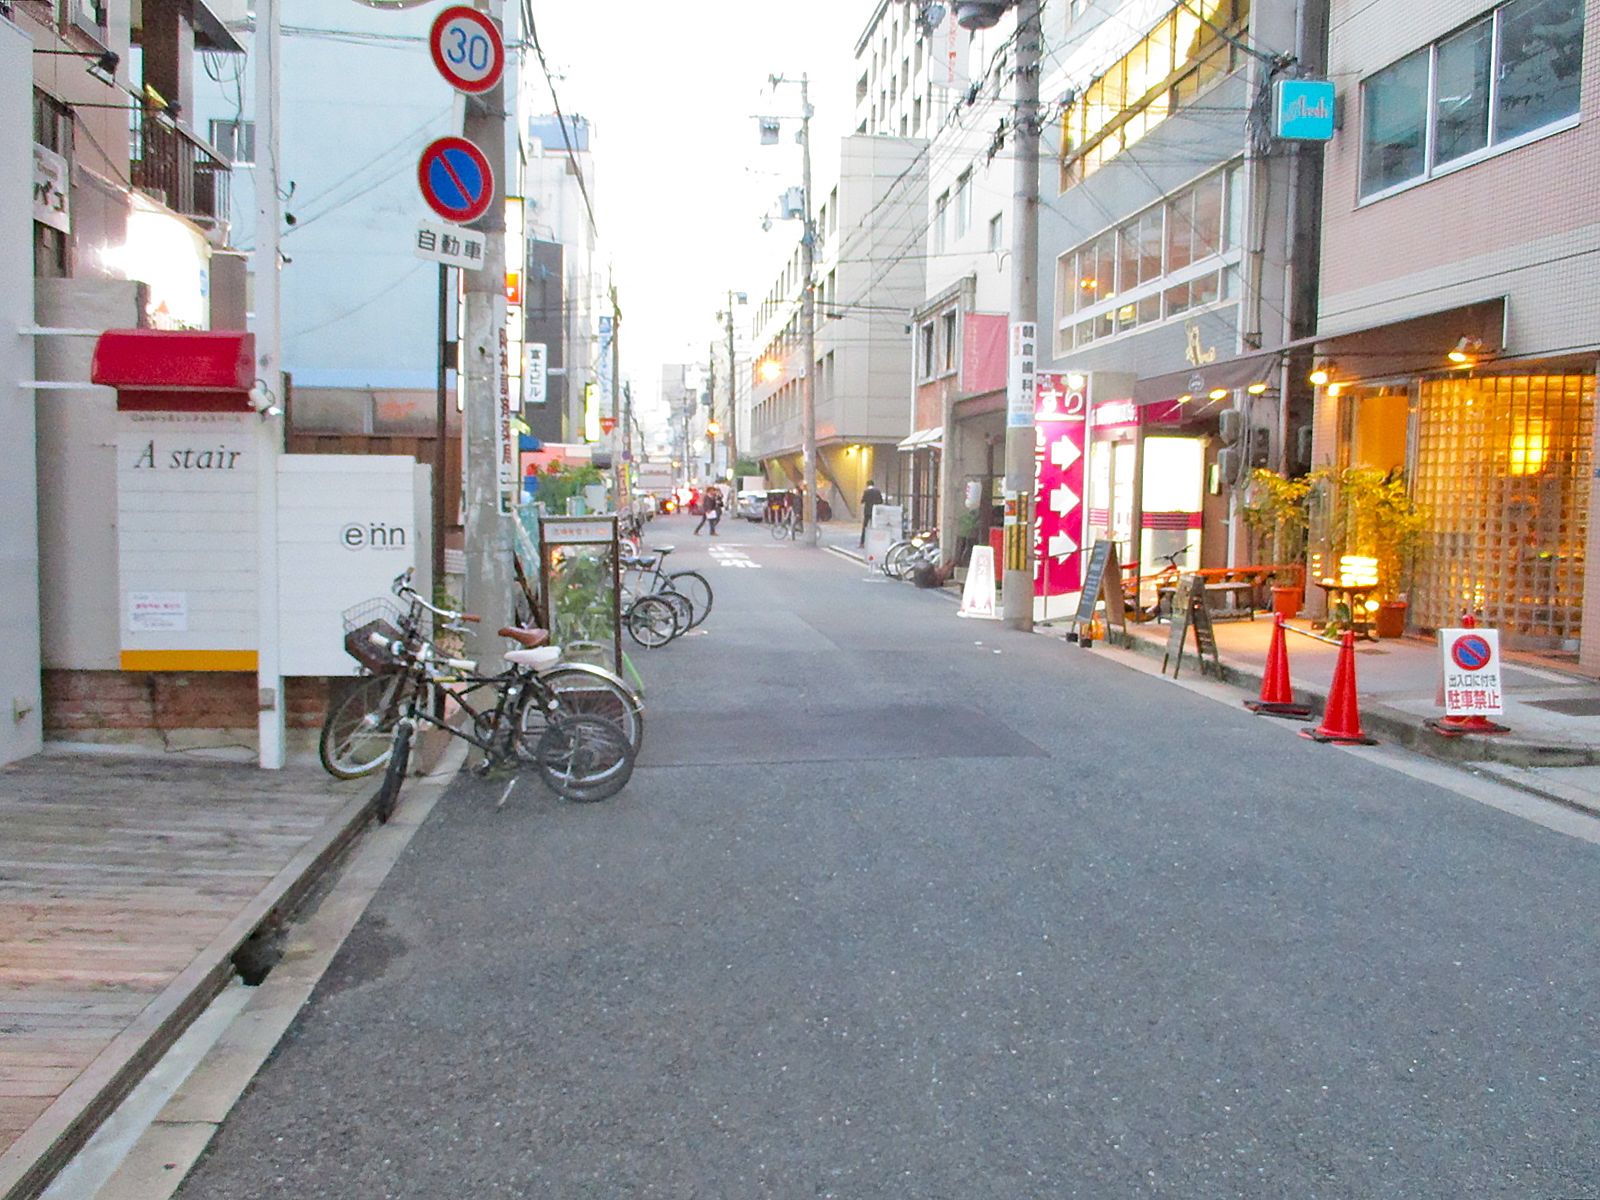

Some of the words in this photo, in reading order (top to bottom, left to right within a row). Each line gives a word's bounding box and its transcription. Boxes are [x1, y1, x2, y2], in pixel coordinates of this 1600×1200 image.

[447, 27, 489, 71] 30
[418, 230, 482, 260] 自動車
[134, 440, 155, 469] A
[169, 445, 241, 469] stair
[1448, 674, 1497, 688] 出入口に付き
[1448, 690, 1501, 710] 駐車禁止
